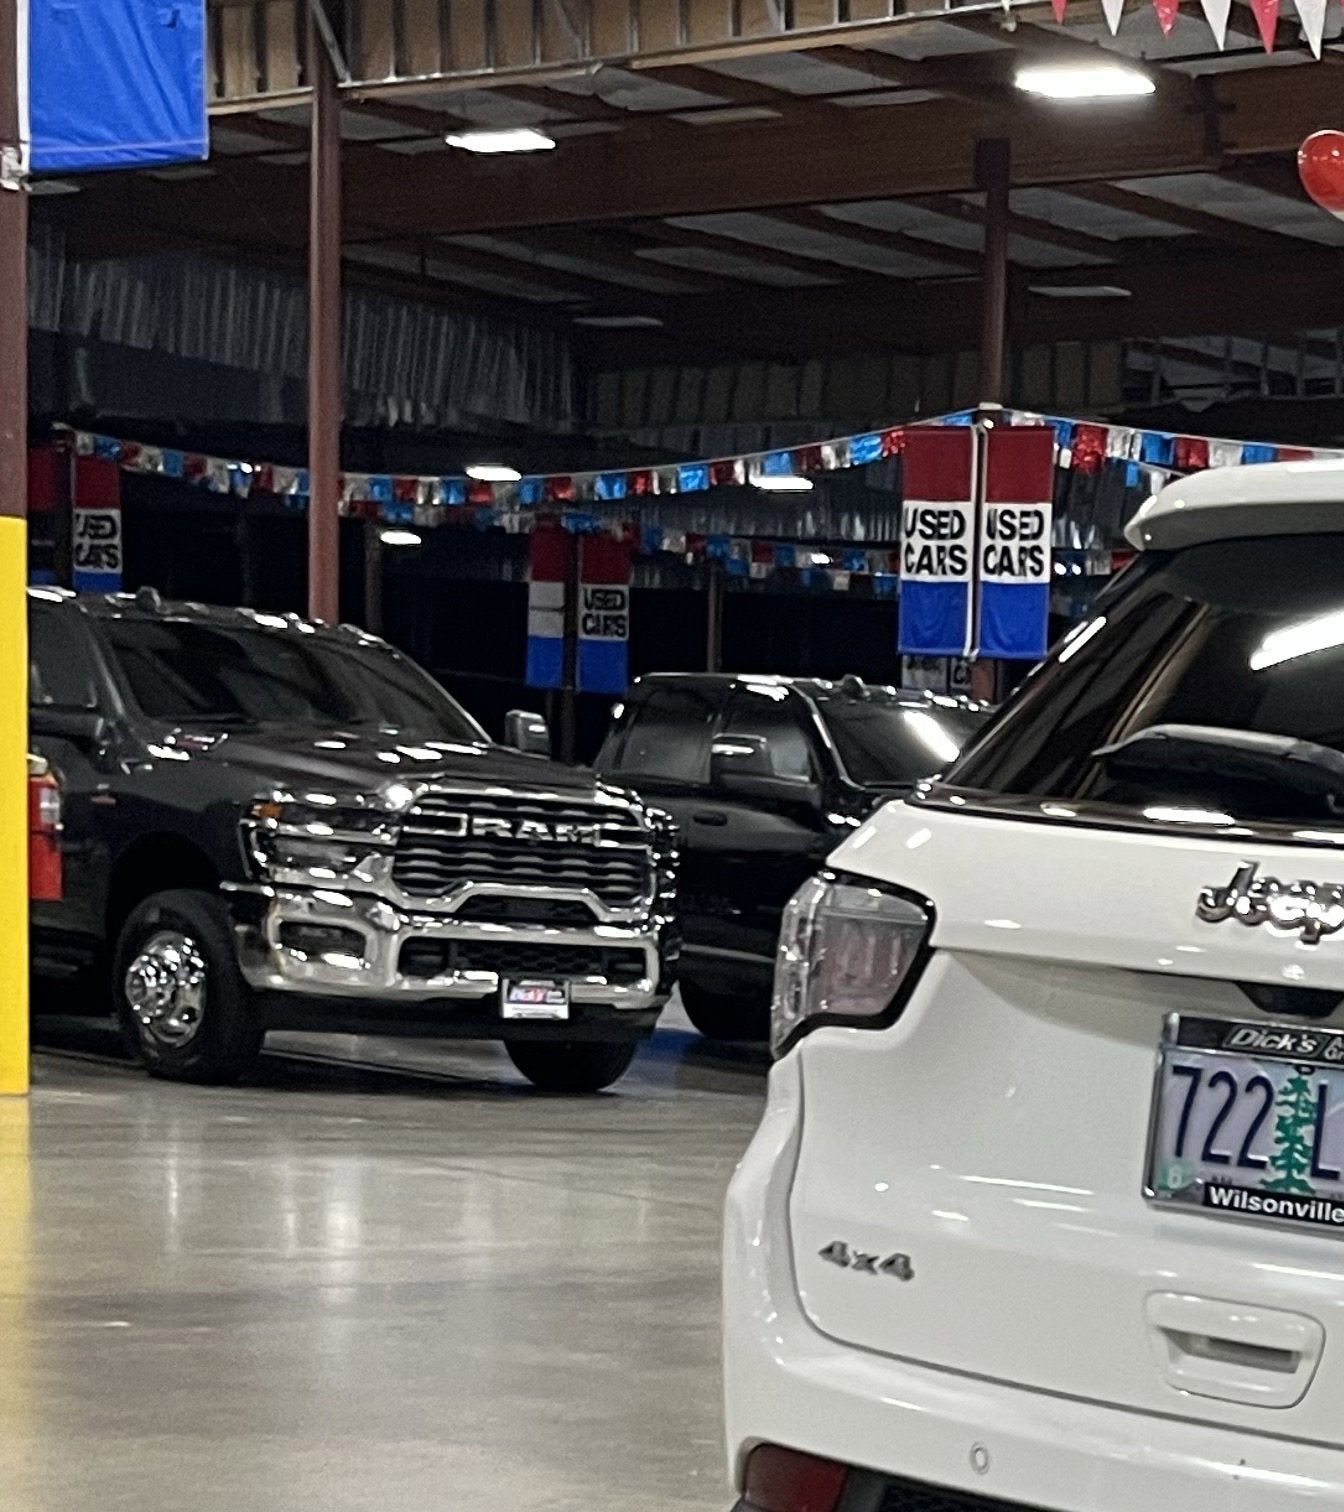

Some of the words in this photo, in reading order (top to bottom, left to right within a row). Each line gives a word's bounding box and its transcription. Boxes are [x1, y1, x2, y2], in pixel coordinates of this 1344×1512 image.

[904, 507, 967, 540] USED
[986, 509, 1045, 541] USED
[905, 542, 967, 576] CARS
[983, 544, 1044, 577] CARS
[1230, 1028, 1318, 1053] Dick's
[1172, 1065, 1275, 1170] 722
[817, 1240, 916, 1282] 4x4
